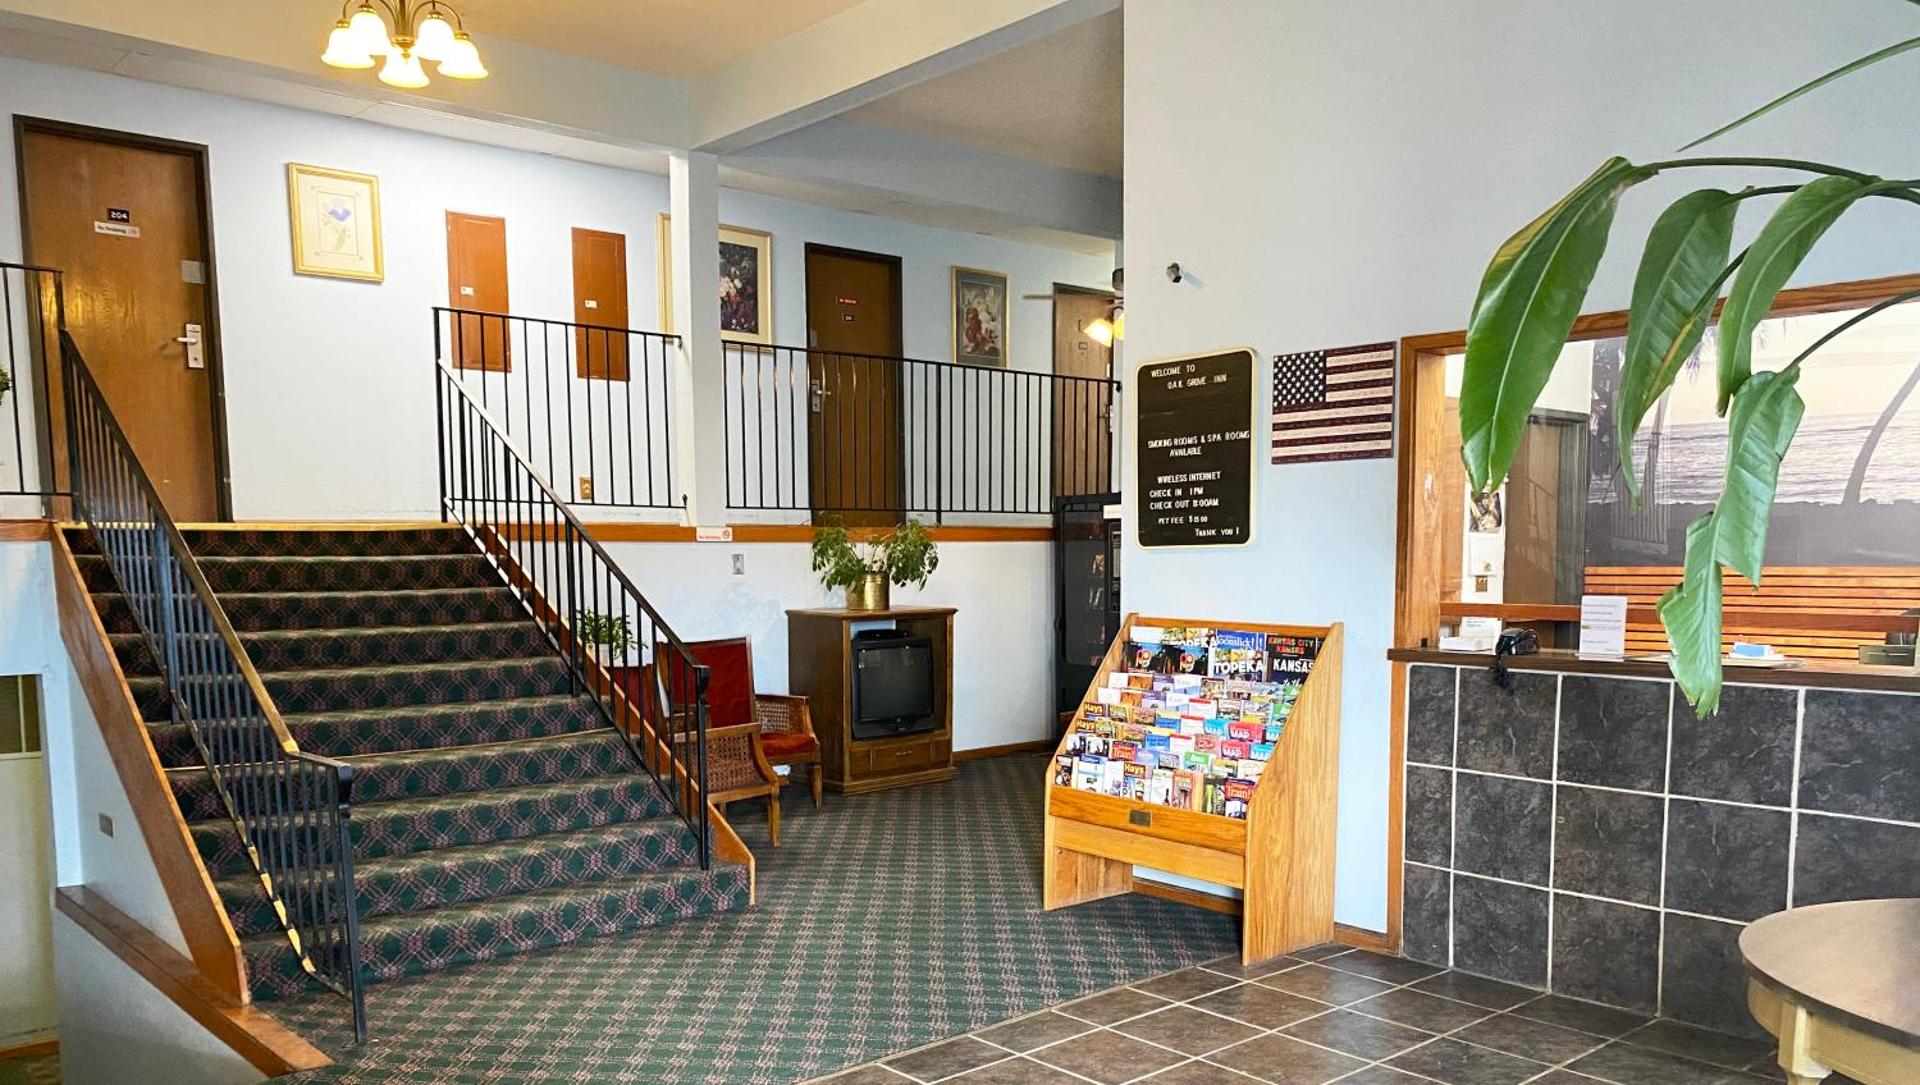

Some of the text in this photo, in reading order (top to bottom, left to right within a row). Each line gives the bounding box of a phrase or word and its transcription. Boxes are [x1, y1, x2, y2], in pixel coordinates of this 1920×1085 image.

[110, 211, 128, 219] 204
[1150, 364, 1196, 378] WELCOME TO
[1167, 373, 1227, 390] OAK GROVE INN
[1147, 438, 1173, 449] SMOKING
[1173, 435, 1198, 446] ROOMS
[1207, 433, 1222, 443] SPA
[1224, 430, 1250, 441] ROOMS
[1169, 446, 1202, 458] AVAILABLE
[1157, 471, 1222, 484] WIRELESS INTERNET
[1149, 489, 1172, 499] CHECK
[1174, 487, 1183, 497] IN
[1149, 500, 1173, 510] CHECK
[1174, 499, 1190, 509] OUT
[1215, 659, 1264, 674] TOPEKA
[1084, 704, 1103, 715] Hays
[1076, 719, 1095, 731] Hays
[1124, 763, 1144, 775] Hays
